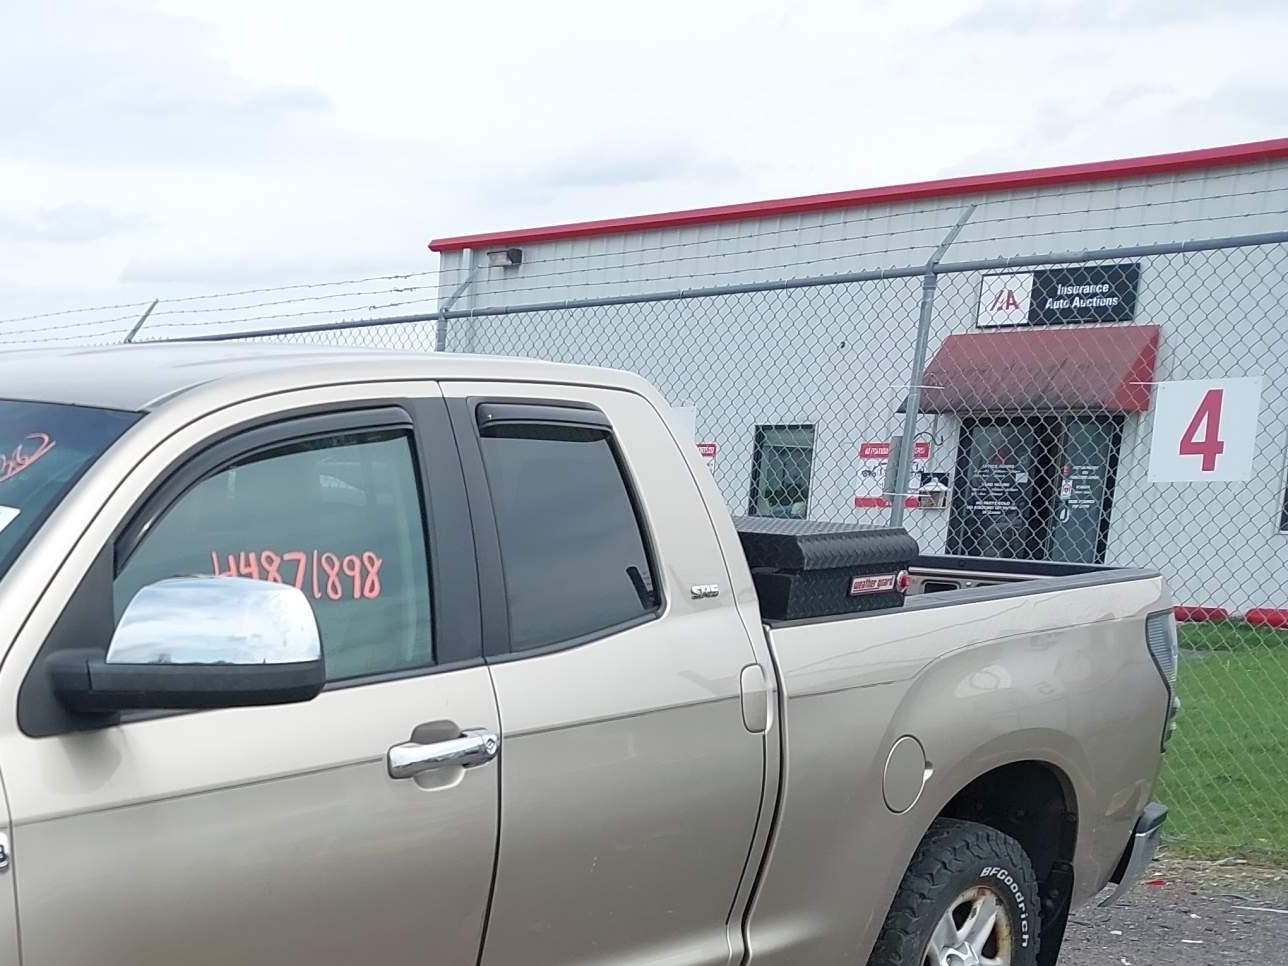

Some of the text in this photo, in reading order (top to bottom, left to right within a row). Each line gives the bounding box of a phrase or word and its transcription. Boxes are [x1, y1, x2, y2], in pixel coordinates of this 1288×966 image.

[1045, 295, 1118, 310] Auto Auctions
[1057, 283, 1109, 296] Insurance
[1179, 389, 1224, 471] 4
[980, 866, 1029, 947] BFGoodrich
